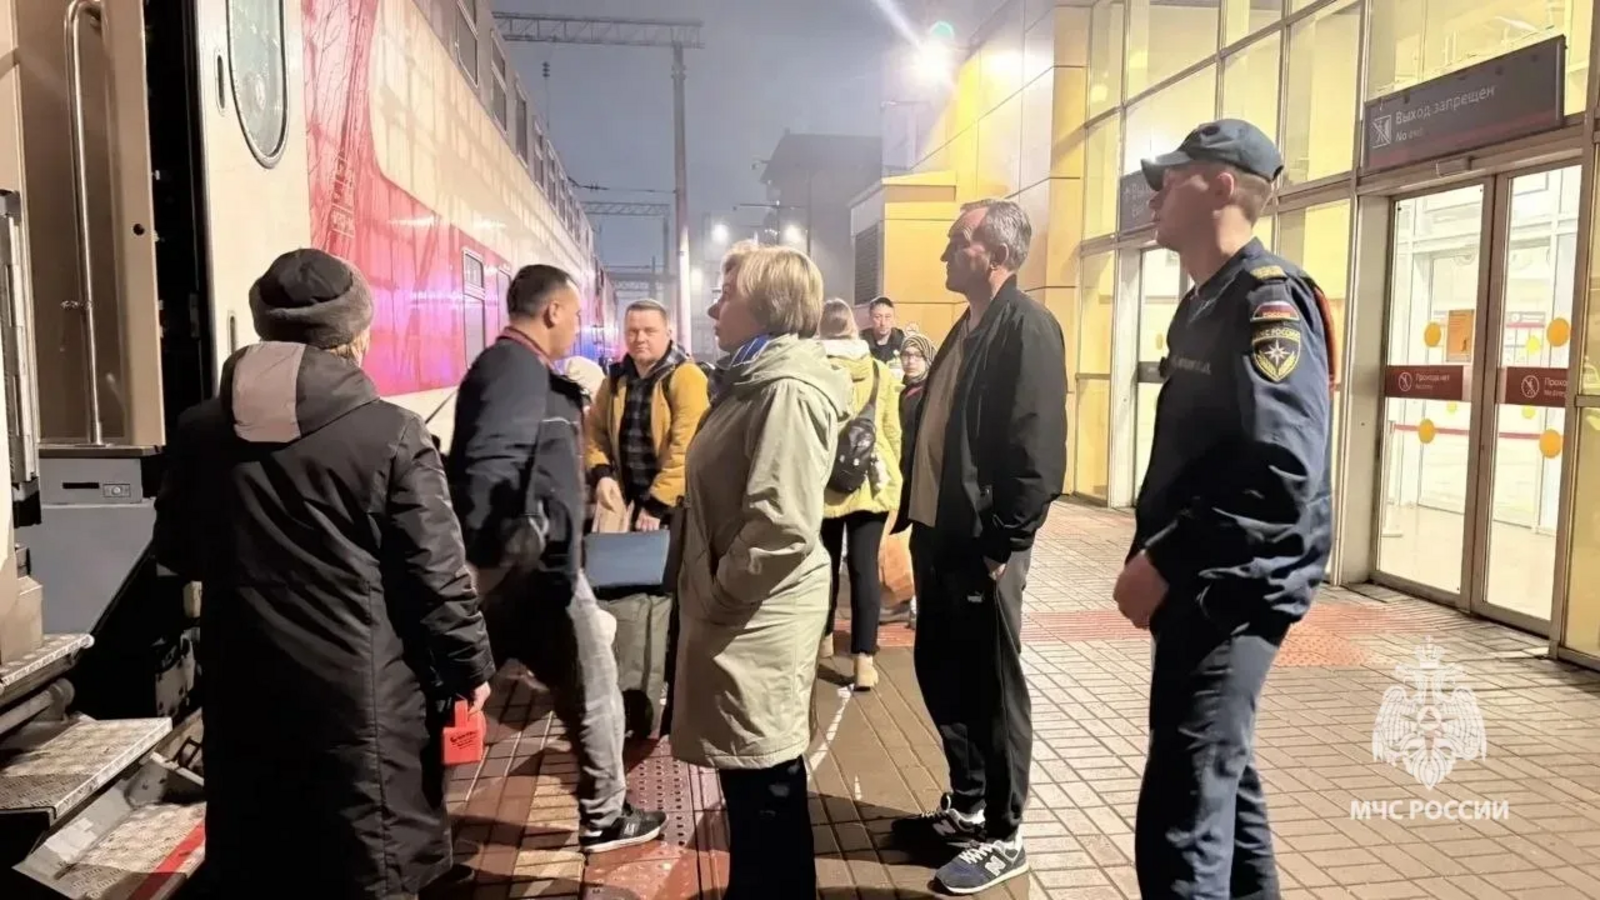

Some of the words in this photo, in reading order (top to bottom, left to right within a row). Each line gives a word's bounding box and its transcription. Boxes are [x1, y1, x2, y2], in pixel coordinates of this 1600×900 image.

[1395, 105, 1431, 125] Выход
[1433, 85, 1496, 113] запрещен
[1395, 131, 1407, 141] No
[985, 856, 1006, 876] N
